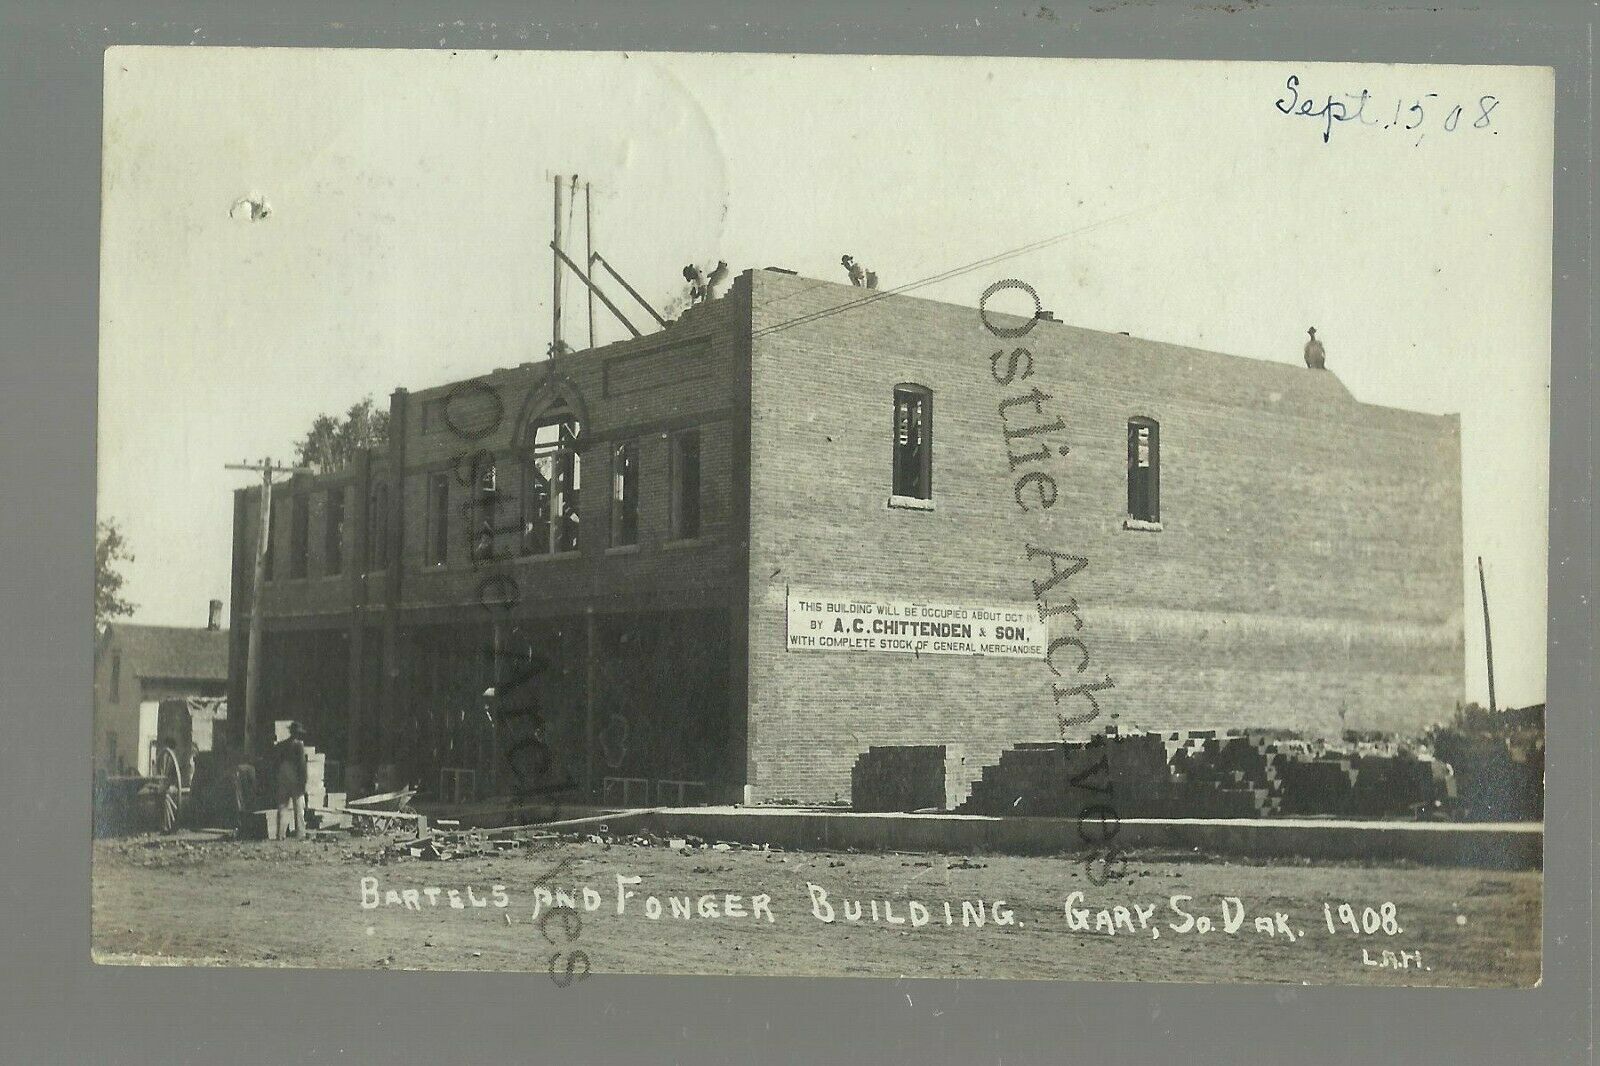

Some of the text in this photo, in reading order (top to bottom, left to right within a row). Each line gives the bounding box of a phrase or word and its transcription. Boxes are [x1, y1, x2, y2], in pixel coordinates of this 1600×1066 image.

[799, 601, 822, 612] THIS
[827, 603, 872, 614] BUILDING
[876, 605, 900, 616] WILL
[904, 607, 918, 617] BE
[921, 608, 968, 619] OCCUPIED
[971, 611, 1002, 622] ABOUT
[810, 620, 823, 630] BY
[978, 627, 987, 638] &
[789, 635, 1042, 655] WITH COMPLETE STOCK OF GENERAL MERCHANDISE
